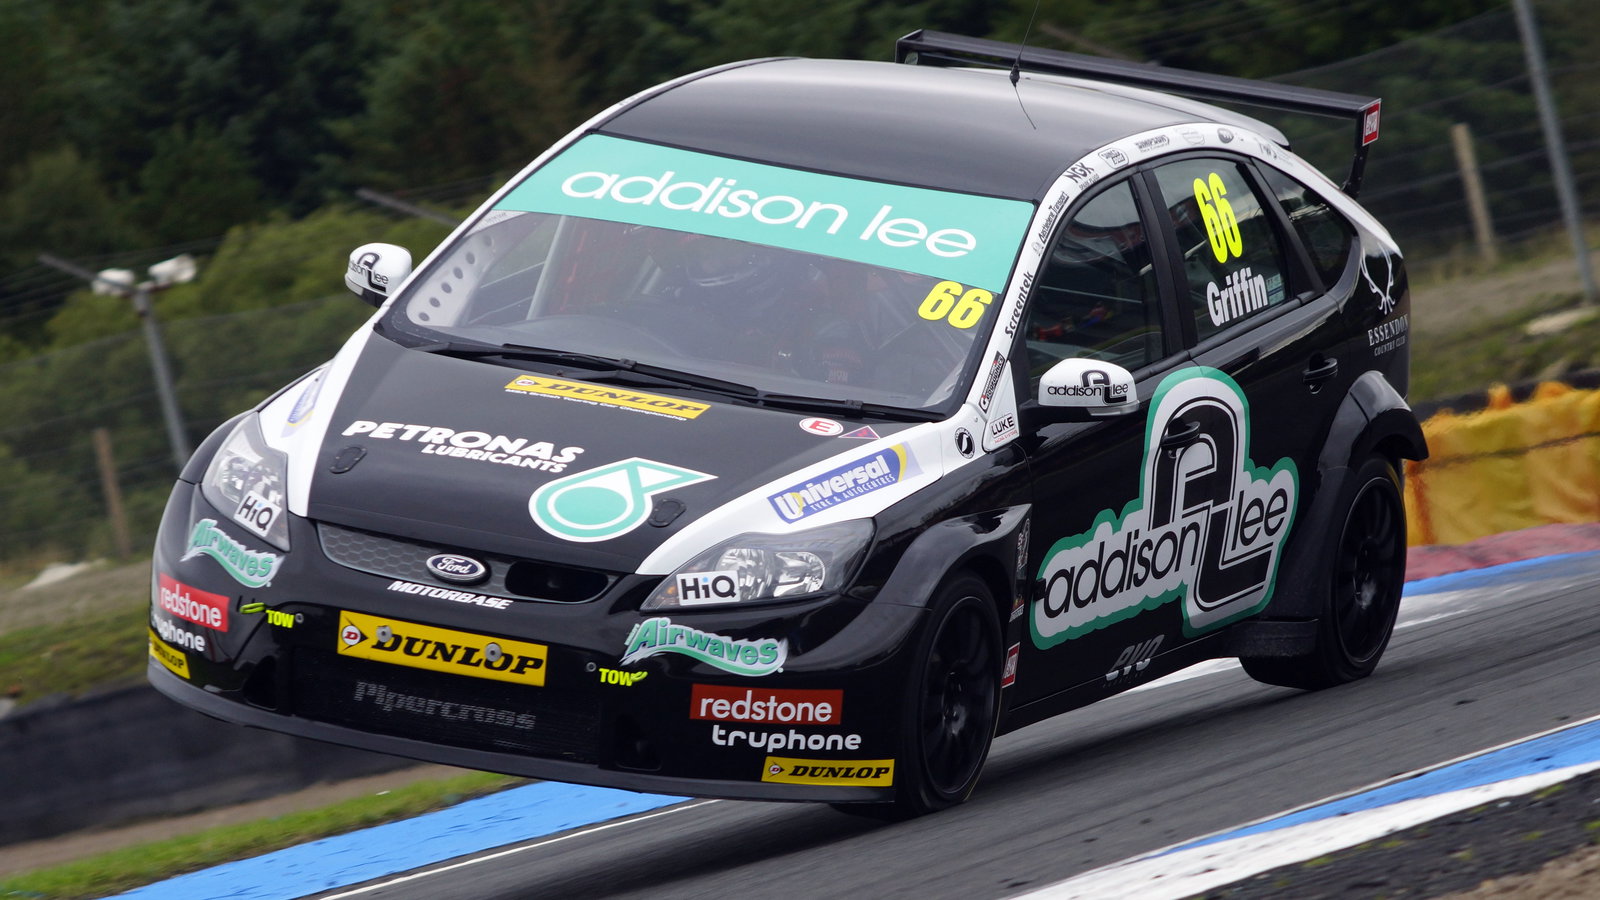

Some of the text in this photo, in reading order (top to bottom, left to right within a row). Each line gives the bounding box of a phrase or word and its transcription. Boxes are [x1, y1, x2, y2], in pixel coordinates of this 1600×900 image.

[1063, 162, 1094, 183] NGK
[561, 171, 977, 258] addison lee
[1193, 172, 1243, 264] 66
[917, 280, 993, 329] 66
[1004, 272, 1034, 338] Screentek
[1206, 267, 1268, 327] Griffin
[1368, 314, 1409, 346] ESSENDON
[543, 383, 703, 411] DUNLOP
[1047, 383, 1129, 397] addison lee
[619, 405, 688, 422] Championship
[809, 420, 835, 433] E
[991, 416, 1015, 436] LUKE
[341, 420, 585, 464] PETRONAS
[421, 443, 568, 473] LUBRICANTS
[773, 454, 891, 520] Universal
[810, 500, 833, 512] TYRE
[842, 473, 896, 498] AUTOCENTRES
[239, 495, 273, 531] HiQ
[190, 521, 274, 577] Airwaves
[437, 556, 471, 574] Ford
[1043, 522, 1201, 619] addison
[1232, 487, 1288, 551] lee
[387, 580, 514, 610] MOTORBASE
[680, 575, 737, 600] HiQ
[161, 583, 222, 627] redstone
[266, 609, 295, 629] TOW
[371, 631, 544, 675] DUNLOP
[625, 618, 780, 666] Airwaves
[599, 668, 634, 687] TOW
[353, 681, 537, 731] Pipercross
[700, 690, 832, 722] redstone
[712, 725, 862, 753] truphone
[788, 766, 890, 780] DUNLOP
